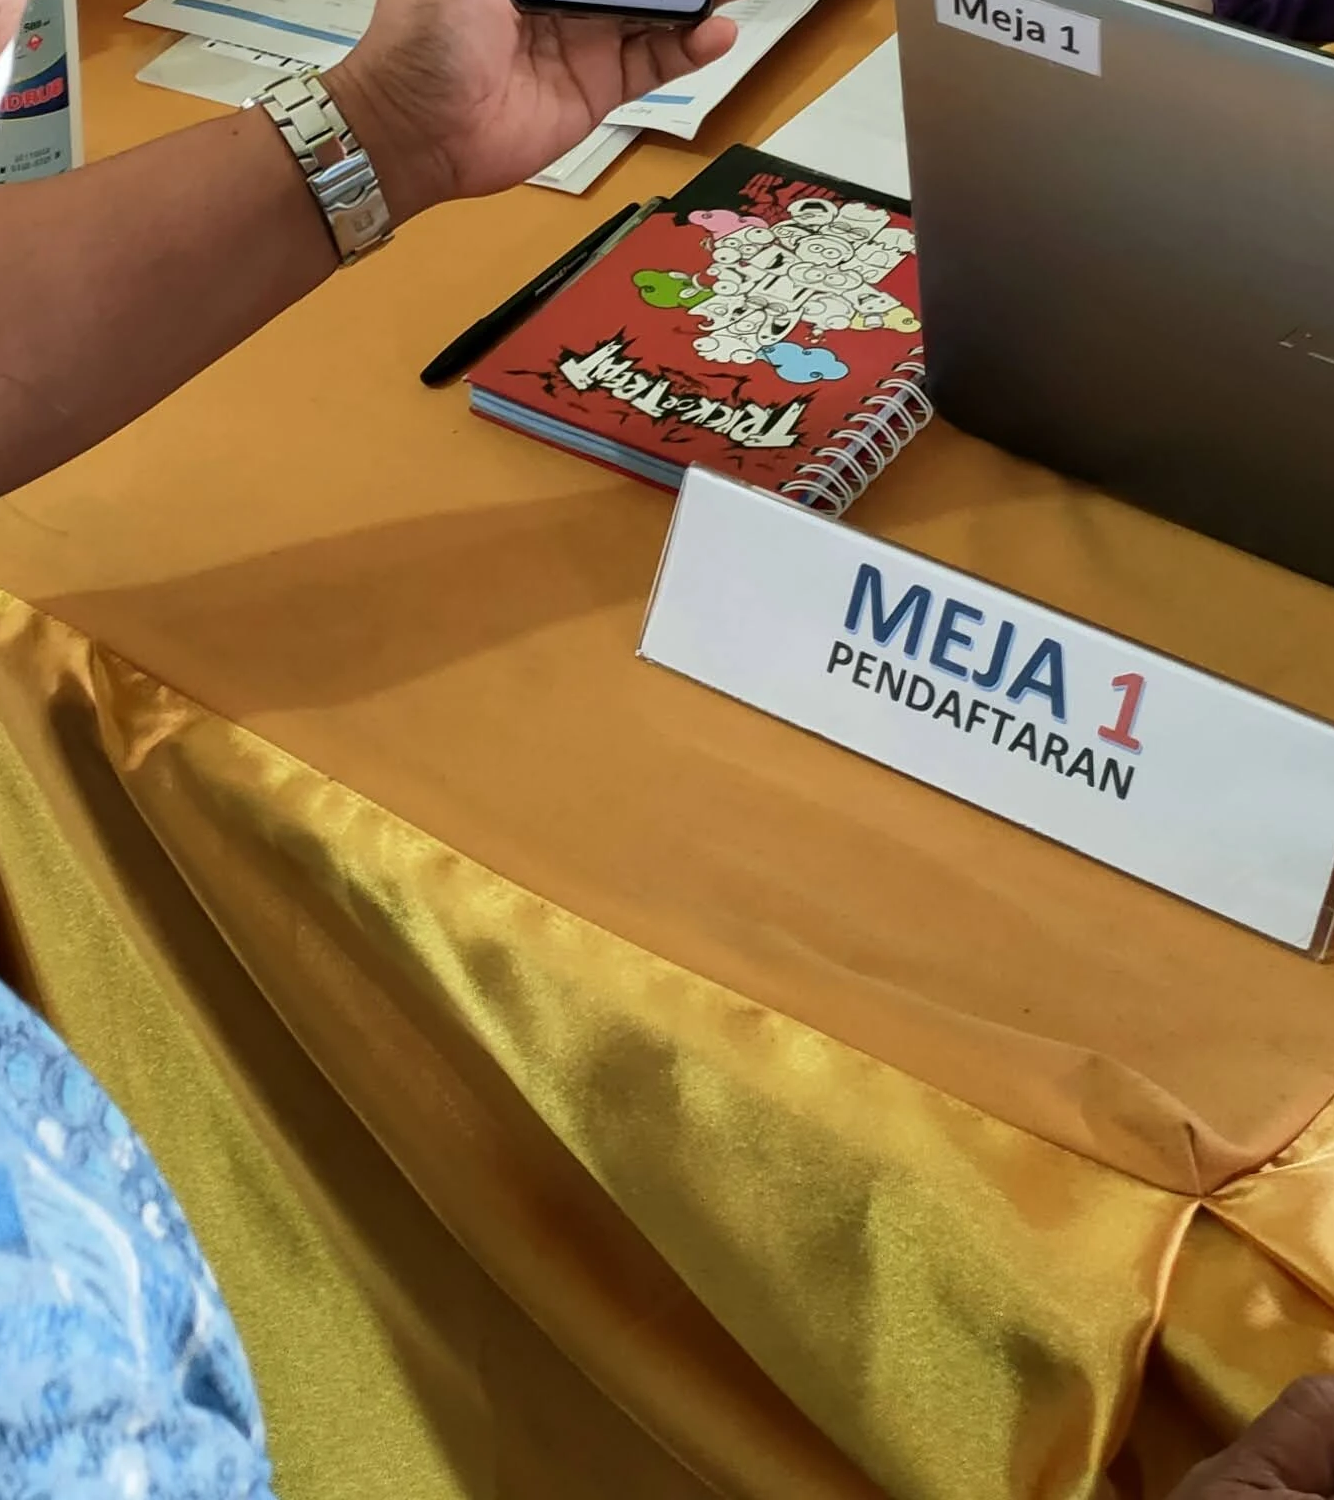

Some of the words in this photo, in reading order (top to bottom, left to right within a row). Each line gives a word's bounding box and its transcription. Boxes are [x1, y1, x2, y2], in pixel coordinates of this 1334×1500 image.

[1059, 25, 1081, 55] 1
[685, 396, 807, 449] TRICK
[842, 562, 1068, 722] MEJA
[1096, 671, 1148, 752] 1
[826, 640, 1138, 802] PENDAFTARAN
